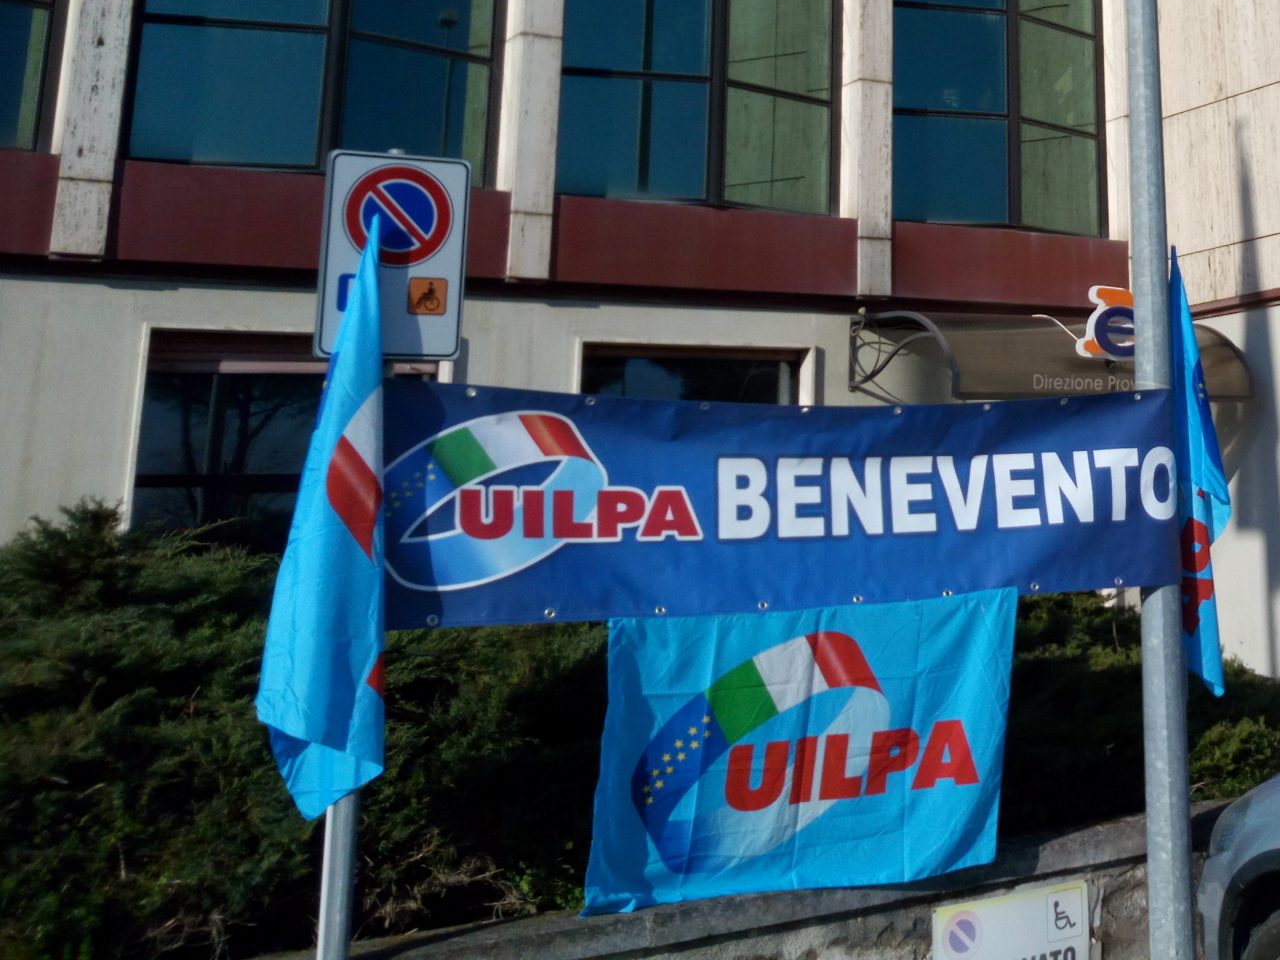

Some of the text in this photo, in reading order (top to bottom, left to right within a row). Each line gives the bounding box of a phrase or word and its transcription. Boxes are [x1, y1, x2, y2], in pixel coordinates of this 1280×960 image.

[1033, 373, 1104, 390] Direzione
[458, 446, 1178, 541] UILPA BENEVENTO
[724, 719, 980, 812] UILPA
